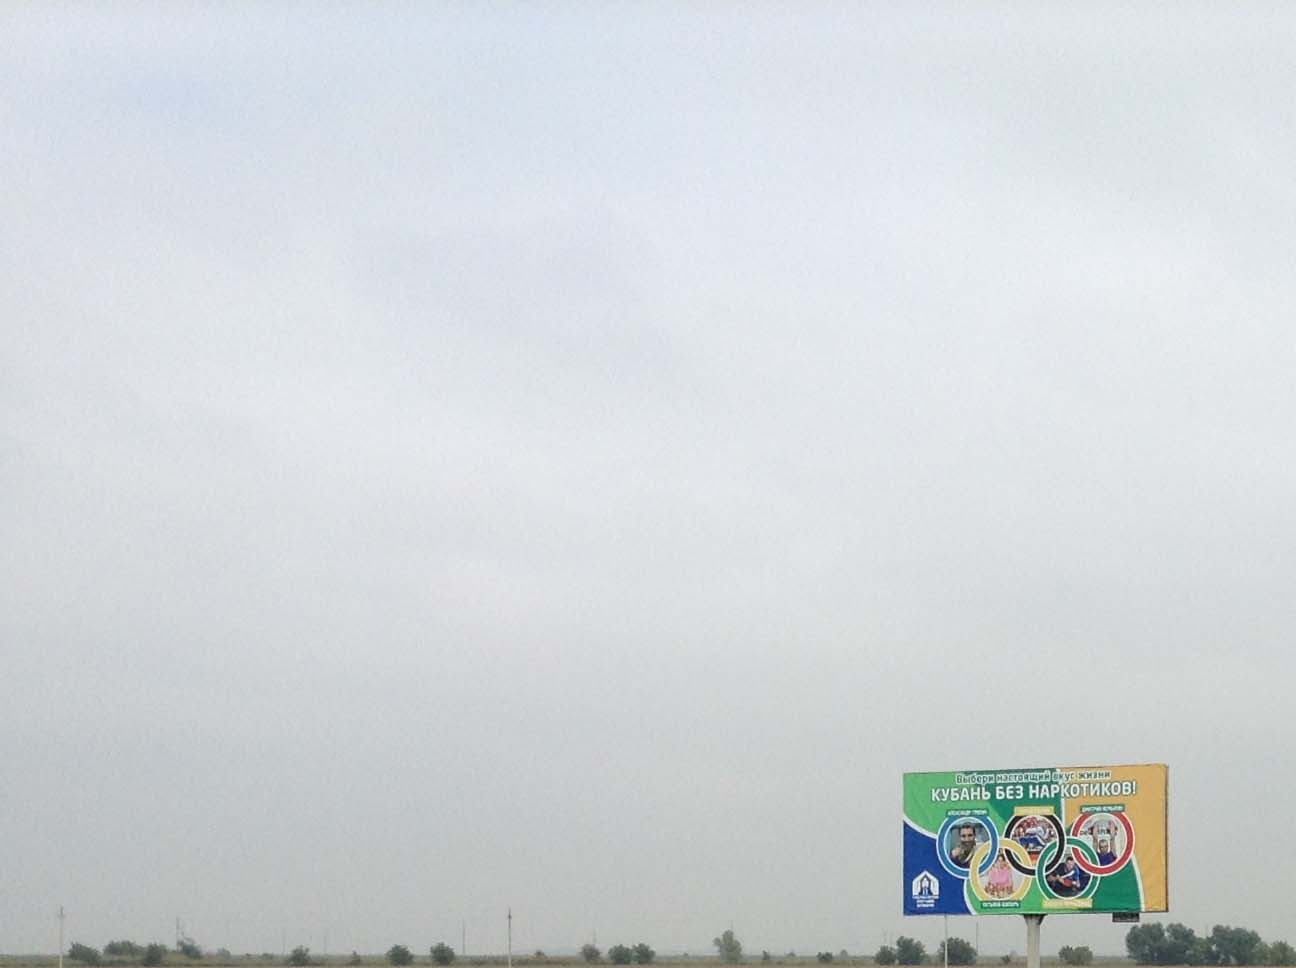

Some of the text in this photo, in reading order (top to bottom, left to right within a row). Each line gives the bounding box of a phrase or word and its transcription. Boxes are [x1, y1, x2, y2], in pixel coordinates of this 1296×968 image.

[955, 773, 995, 784] Выбери
[996, 771, 1051, 783] настоящий
[1077, 769, 1111, 780] жизни
[931, 780, 1137, 802] КУБАНЬ БЕЗ НАРКОТИКОВ!
